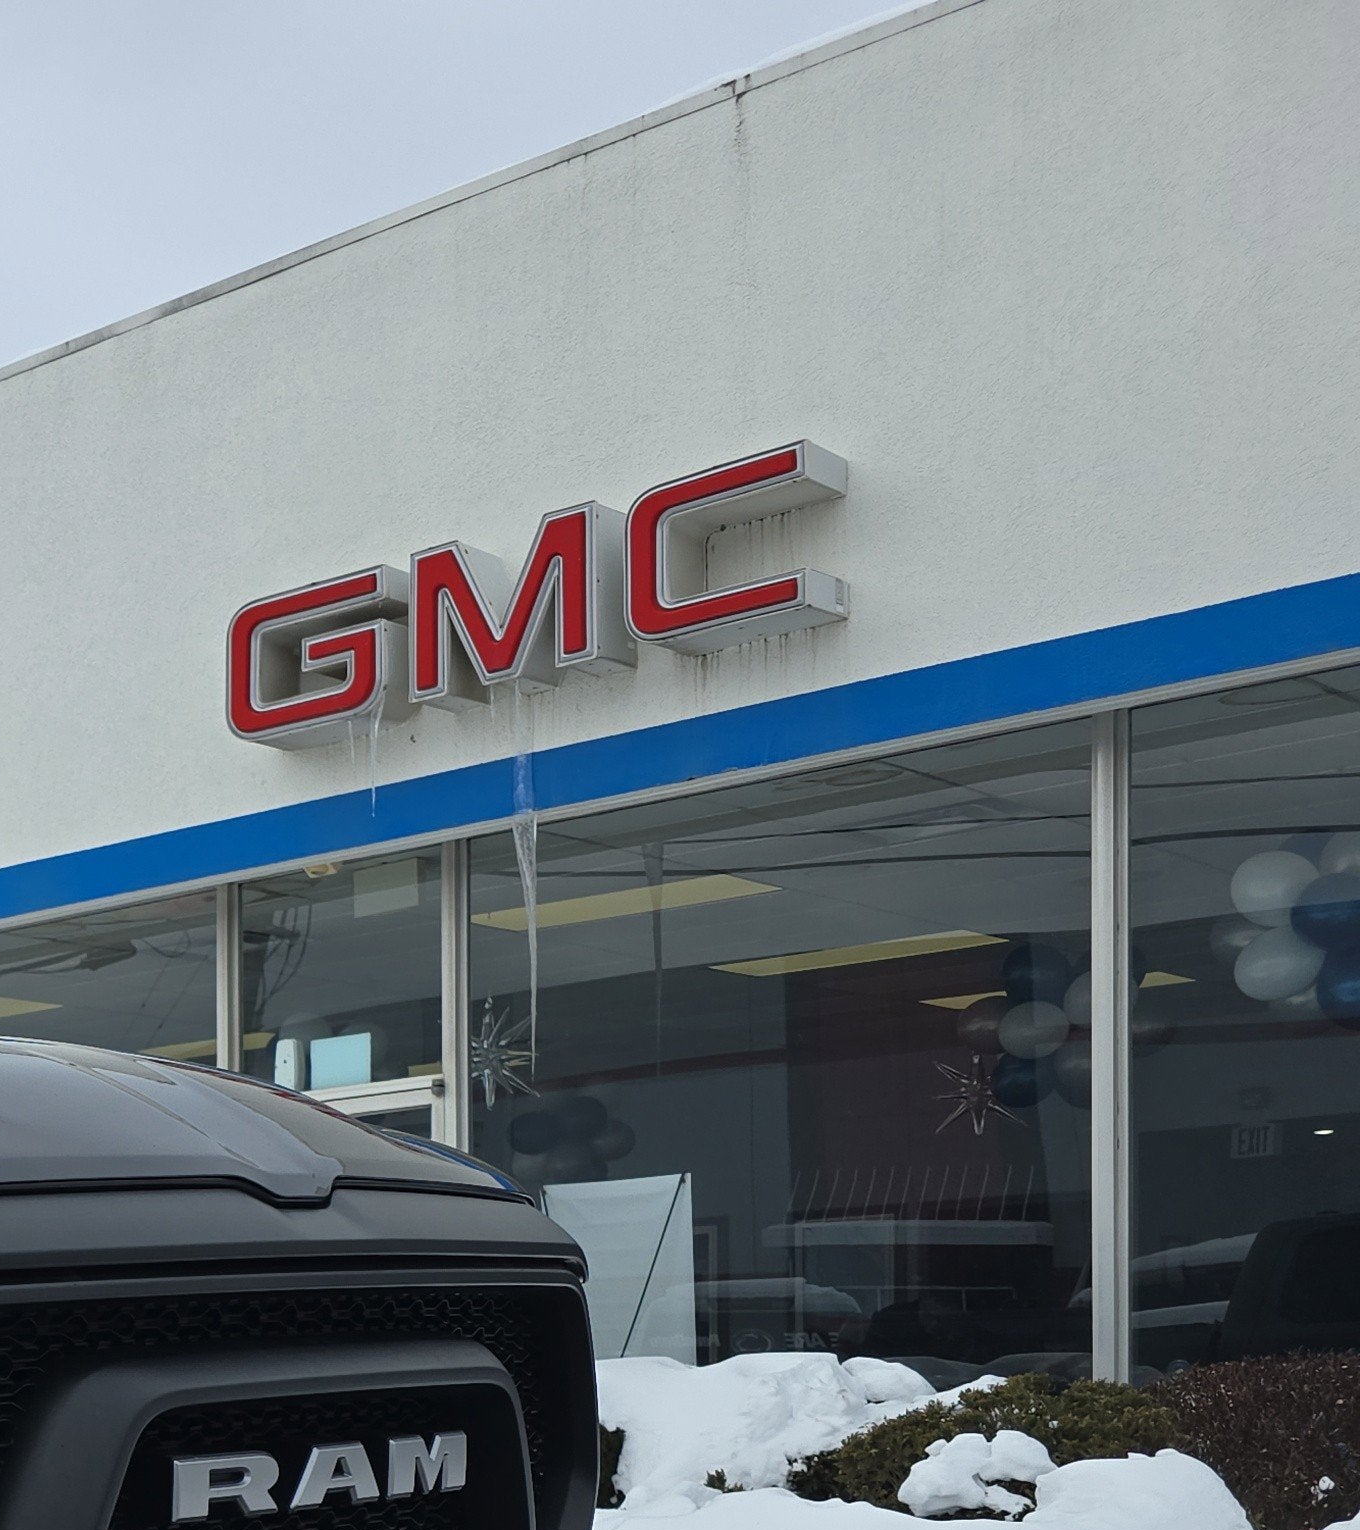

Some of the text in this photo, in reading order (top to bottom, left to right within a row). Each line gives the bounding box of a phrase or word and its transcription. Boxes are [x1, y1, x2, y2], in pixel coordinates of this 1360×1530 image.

[226, 439, 808, 742] GMC
[1238, 1127, 1270, 1154] EXIT
[171, 1430, 468, 1523] RAM
